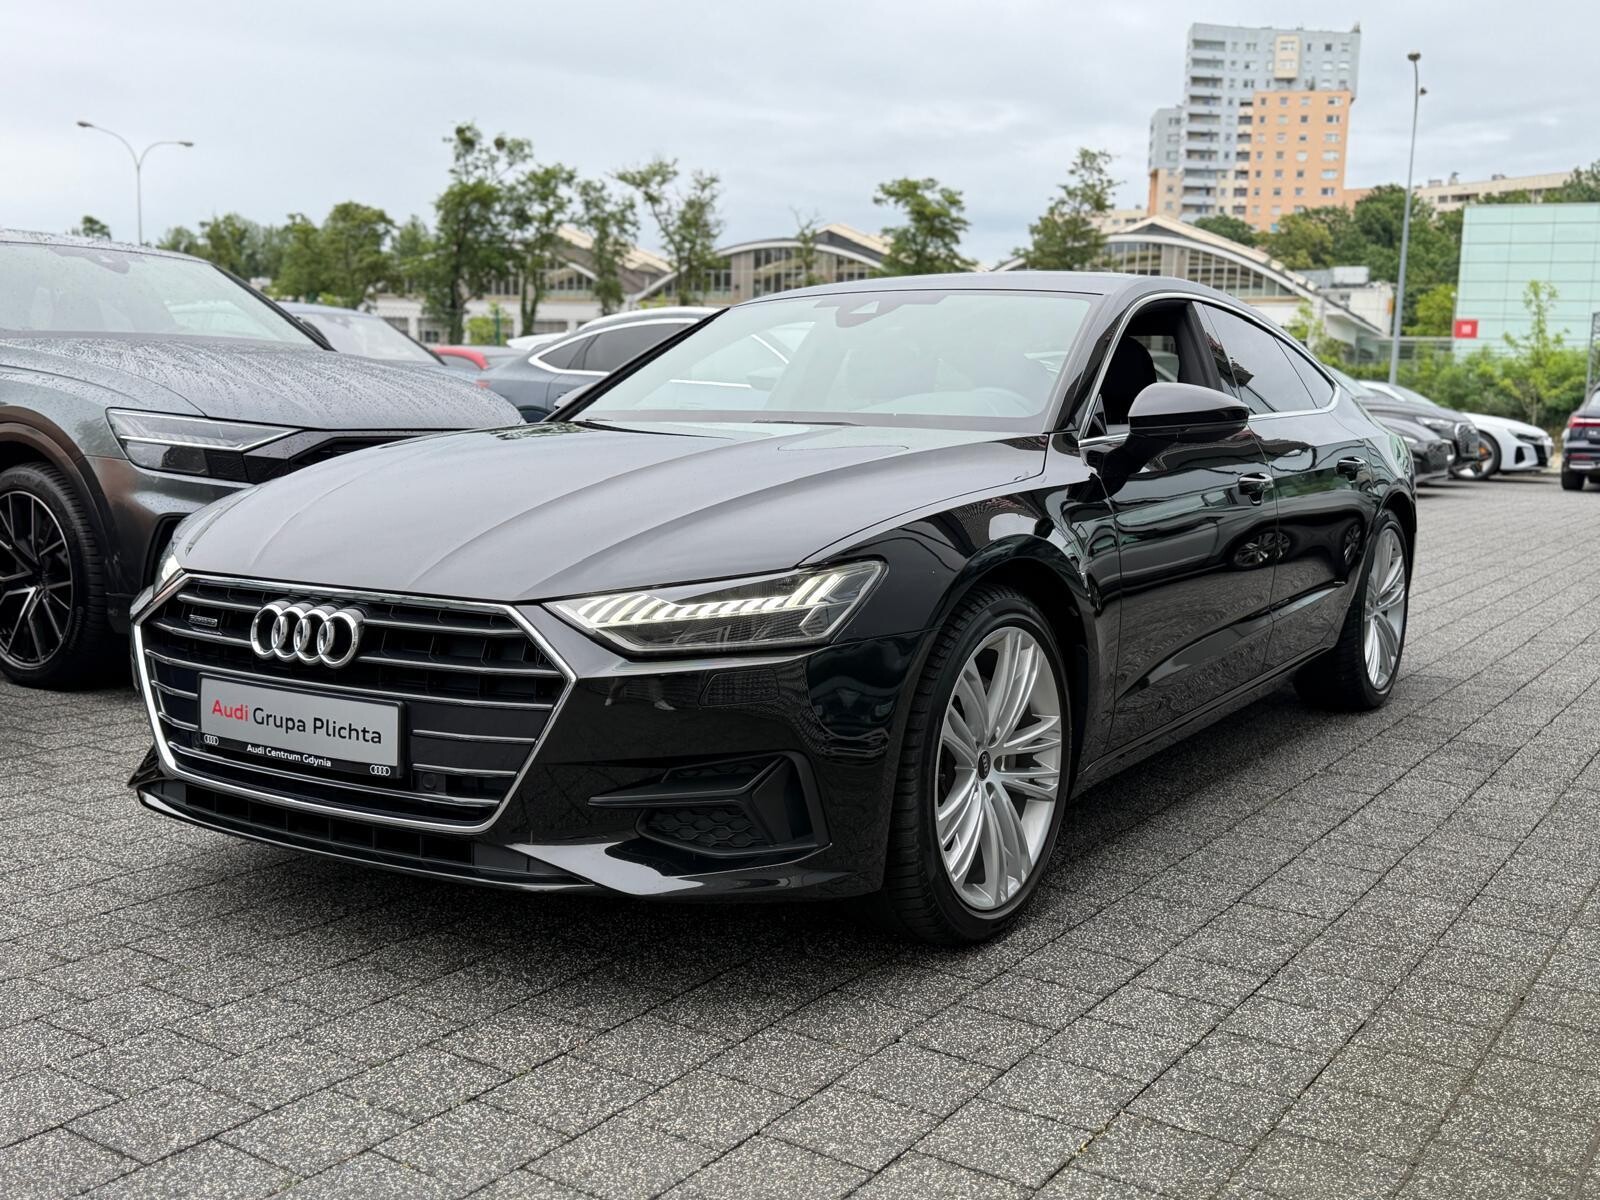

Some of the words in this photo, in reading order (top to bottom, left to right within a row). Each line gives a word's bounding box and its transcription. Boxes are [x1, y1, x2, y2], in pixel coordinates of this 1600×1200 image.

[212, 699, 249, 722] Audi
[253, 707, 306, 734] Grupa
[313, 717, 382, 744] Plichta
[247, 744, 265, 755] Audi
[266, 747, 301, 762] Centrum
[302, 754, 332, 767] Gdynia
